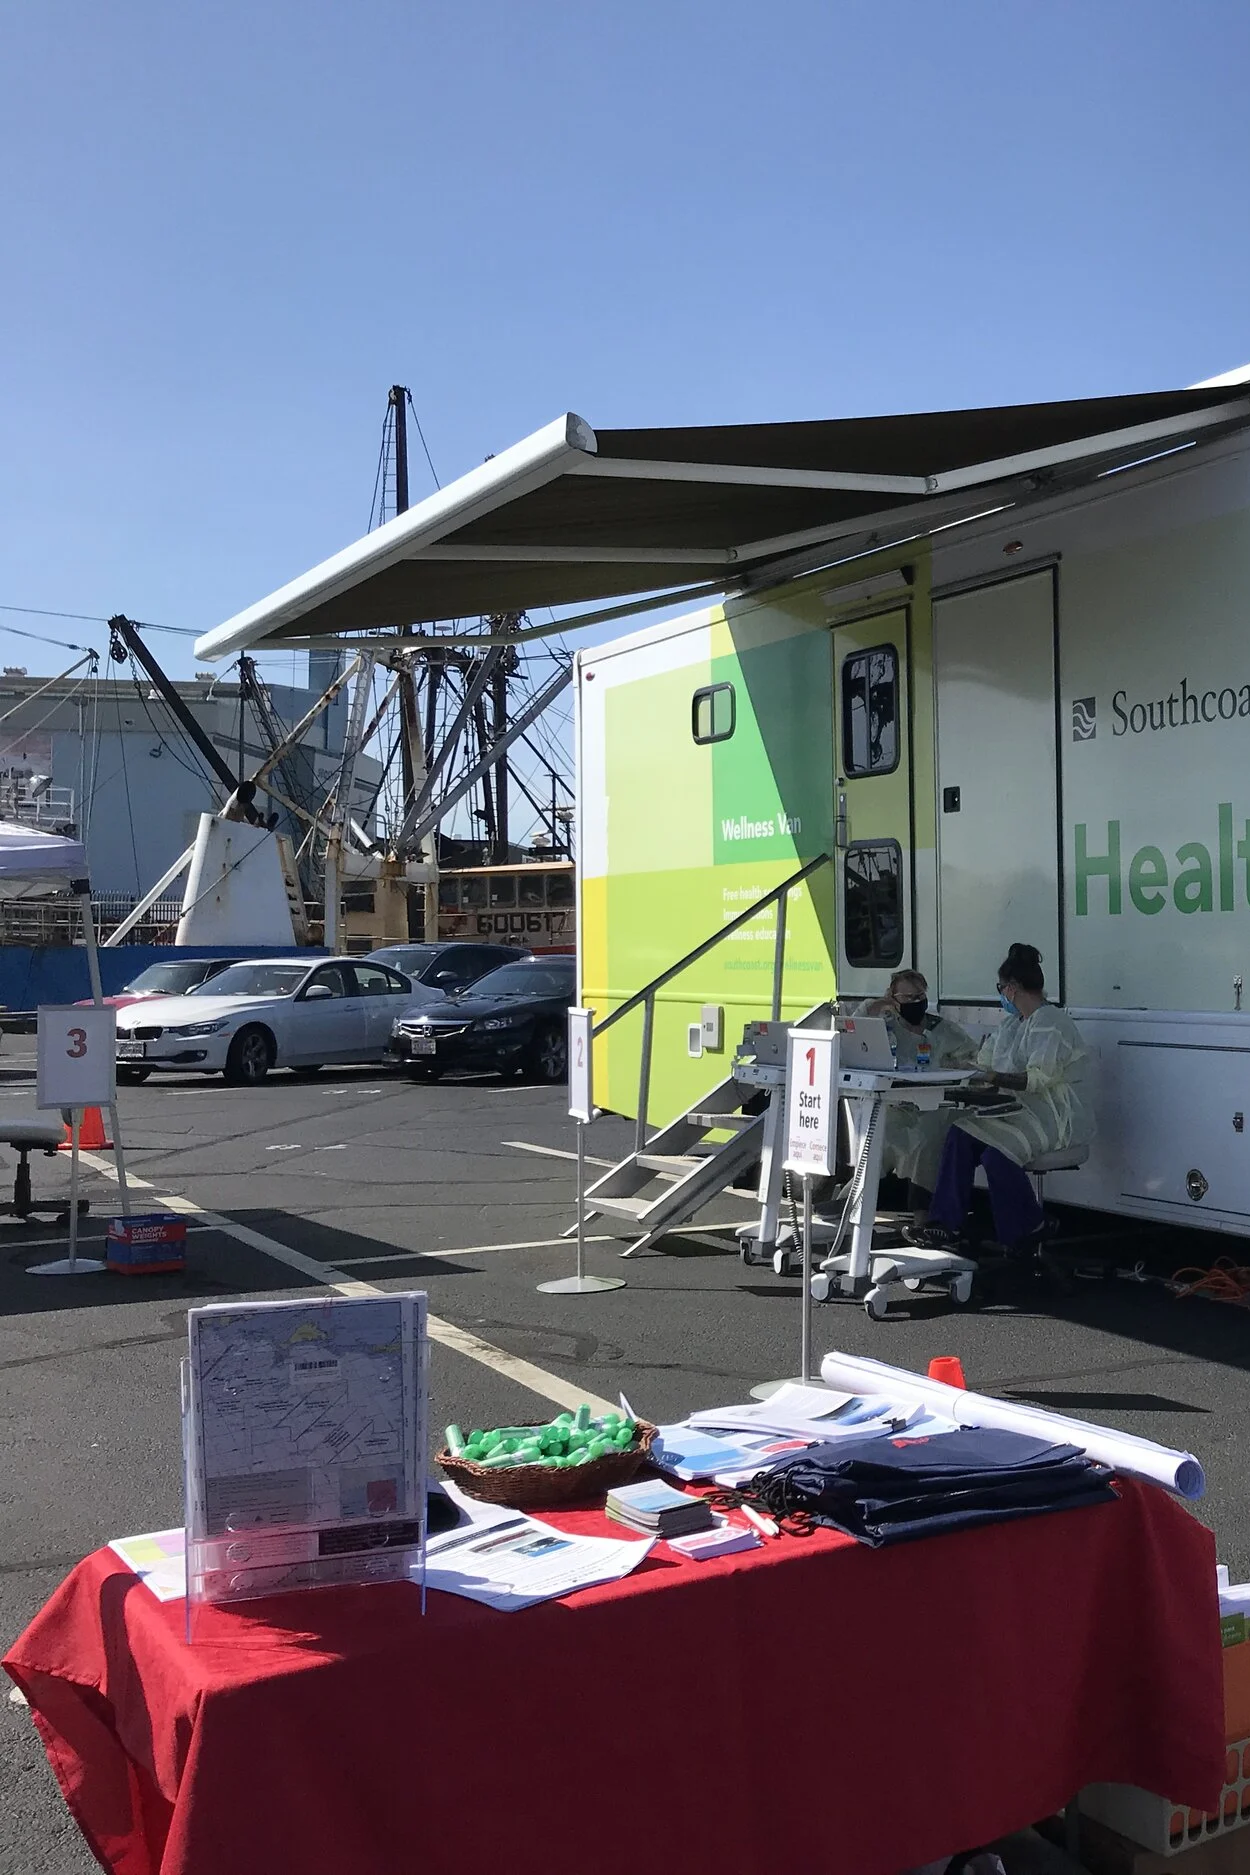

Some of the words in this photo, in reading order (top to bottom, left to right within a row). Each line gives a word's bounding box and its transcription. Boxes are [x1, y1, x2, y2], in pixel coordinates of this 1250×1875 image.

[721, 816, 774, 841] Wellness
[777, 813, 801, 835] Van
[723, 888, 738, 901] Free
[740, 885, 762, 900] health
[66, 1028, 87, 1058] 3
[577, 1036, 583, 1068] 2
[806, 1047, 816, 1087] 1
[799, 1091, 822, 1110] Start
[799, 1111, 819, 1130] here
[132, 1226, 164, 1234] CANOPY
[132, 1231, 167, 1240] WEIGHTS
